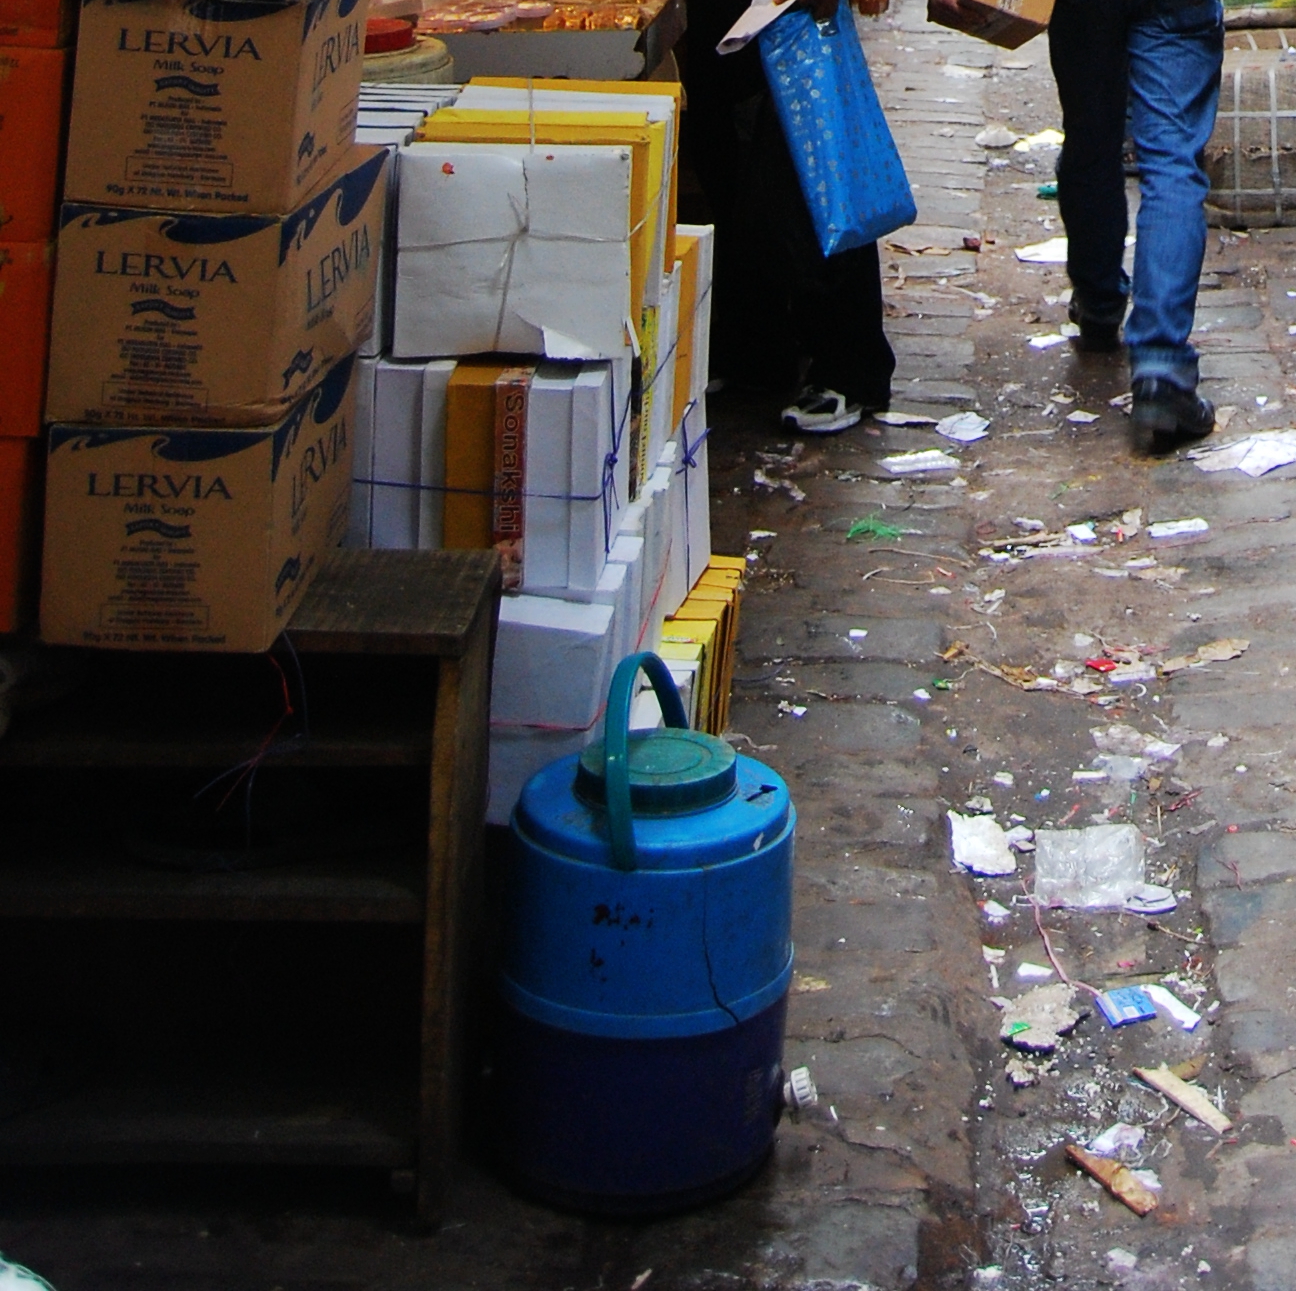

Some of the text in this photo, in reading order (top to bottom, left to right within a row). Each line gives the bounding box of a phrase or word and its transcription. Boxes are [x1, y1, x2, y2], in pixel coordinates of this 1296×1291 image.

[118, 28, 263, 61] LERVIA
[153, 59, 225, 75] Milk Soap
[95, 250, 238, 284] LERVIA
[306, 223, 370, 313] LERVIA
[129, 282, 200, 299] Milk Soap
[500, 393, 525, 533] Sonakshi
[87, 472, 233, 500] LERVIA
[123, 502, 196, 517] Milk Soap
